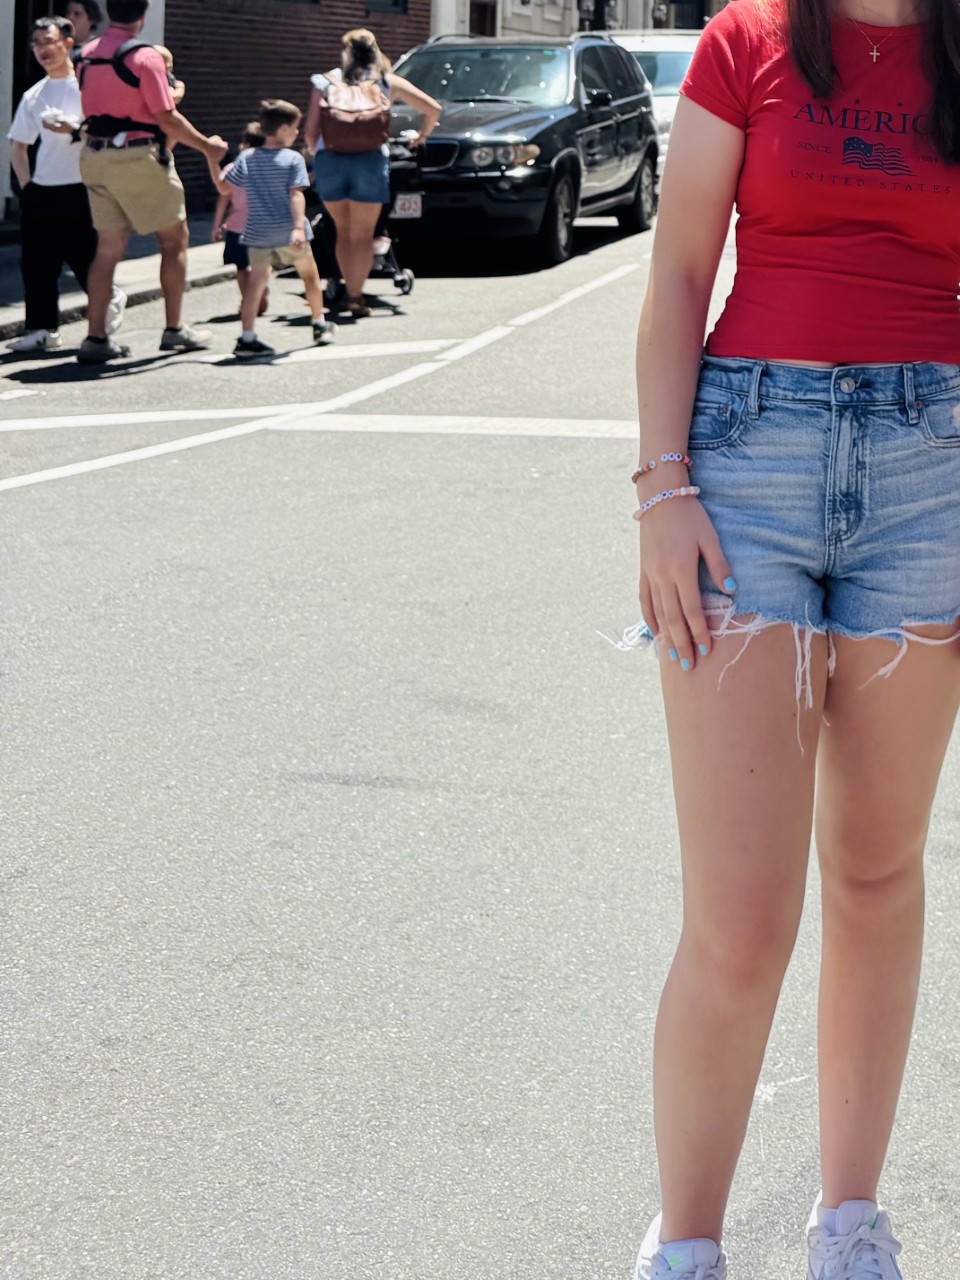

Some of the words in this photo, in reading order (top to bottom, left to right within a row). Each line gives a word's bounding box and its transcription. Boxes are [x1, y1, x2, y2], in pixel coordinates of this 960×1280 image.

[798, 140, 832, 154] SINCE
[790, 169, 865, 187] UNITED
[880, 180, 952, 194] STATES
